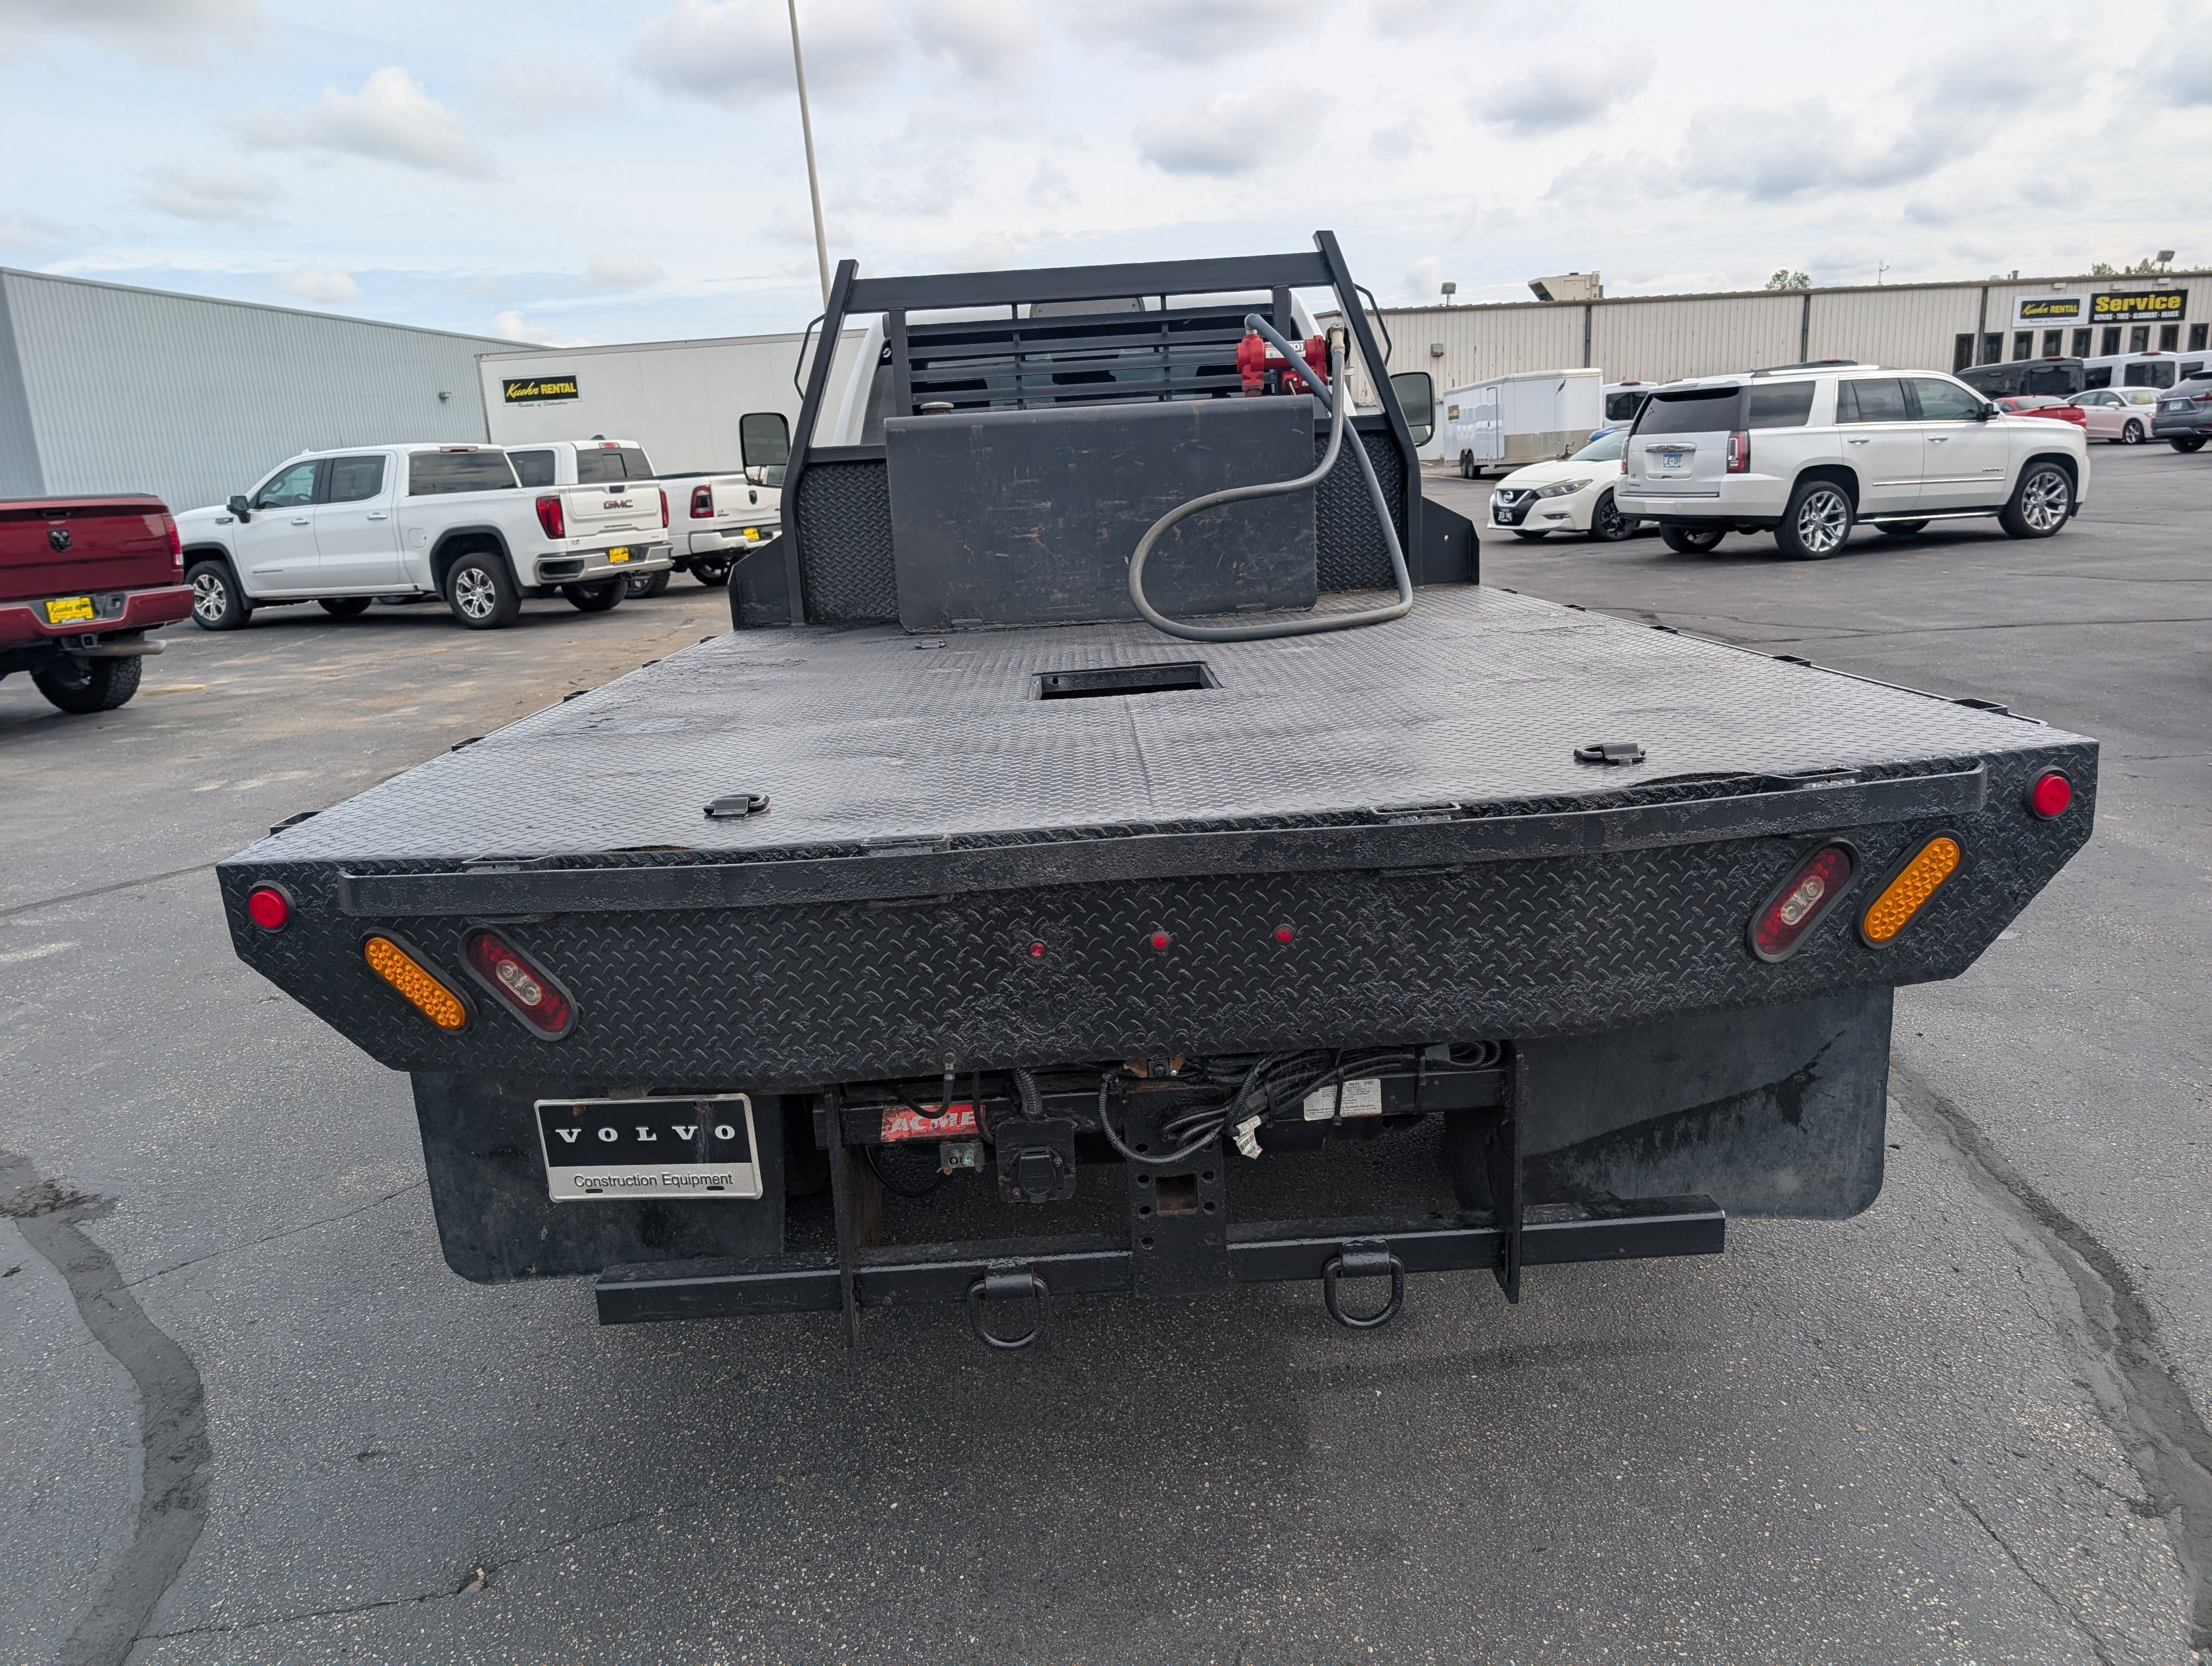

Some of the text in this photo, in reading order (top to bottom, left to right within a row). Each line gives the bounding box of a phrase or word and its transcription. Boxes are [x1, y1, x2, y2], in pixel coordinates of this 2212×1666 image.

[2050, 305, 2078, 313] RENTAL
[2095, 294, 2182, 312] Service
[506, 382, 577, 399] Kuehn RENTAL
[603, 499, 633, 510] GMC
[890, 1111, 976, 1132] ACME
[555, 1124, 735, 1143] VOLVO
[574, 1172, 733, 1188] Construction Equipment
